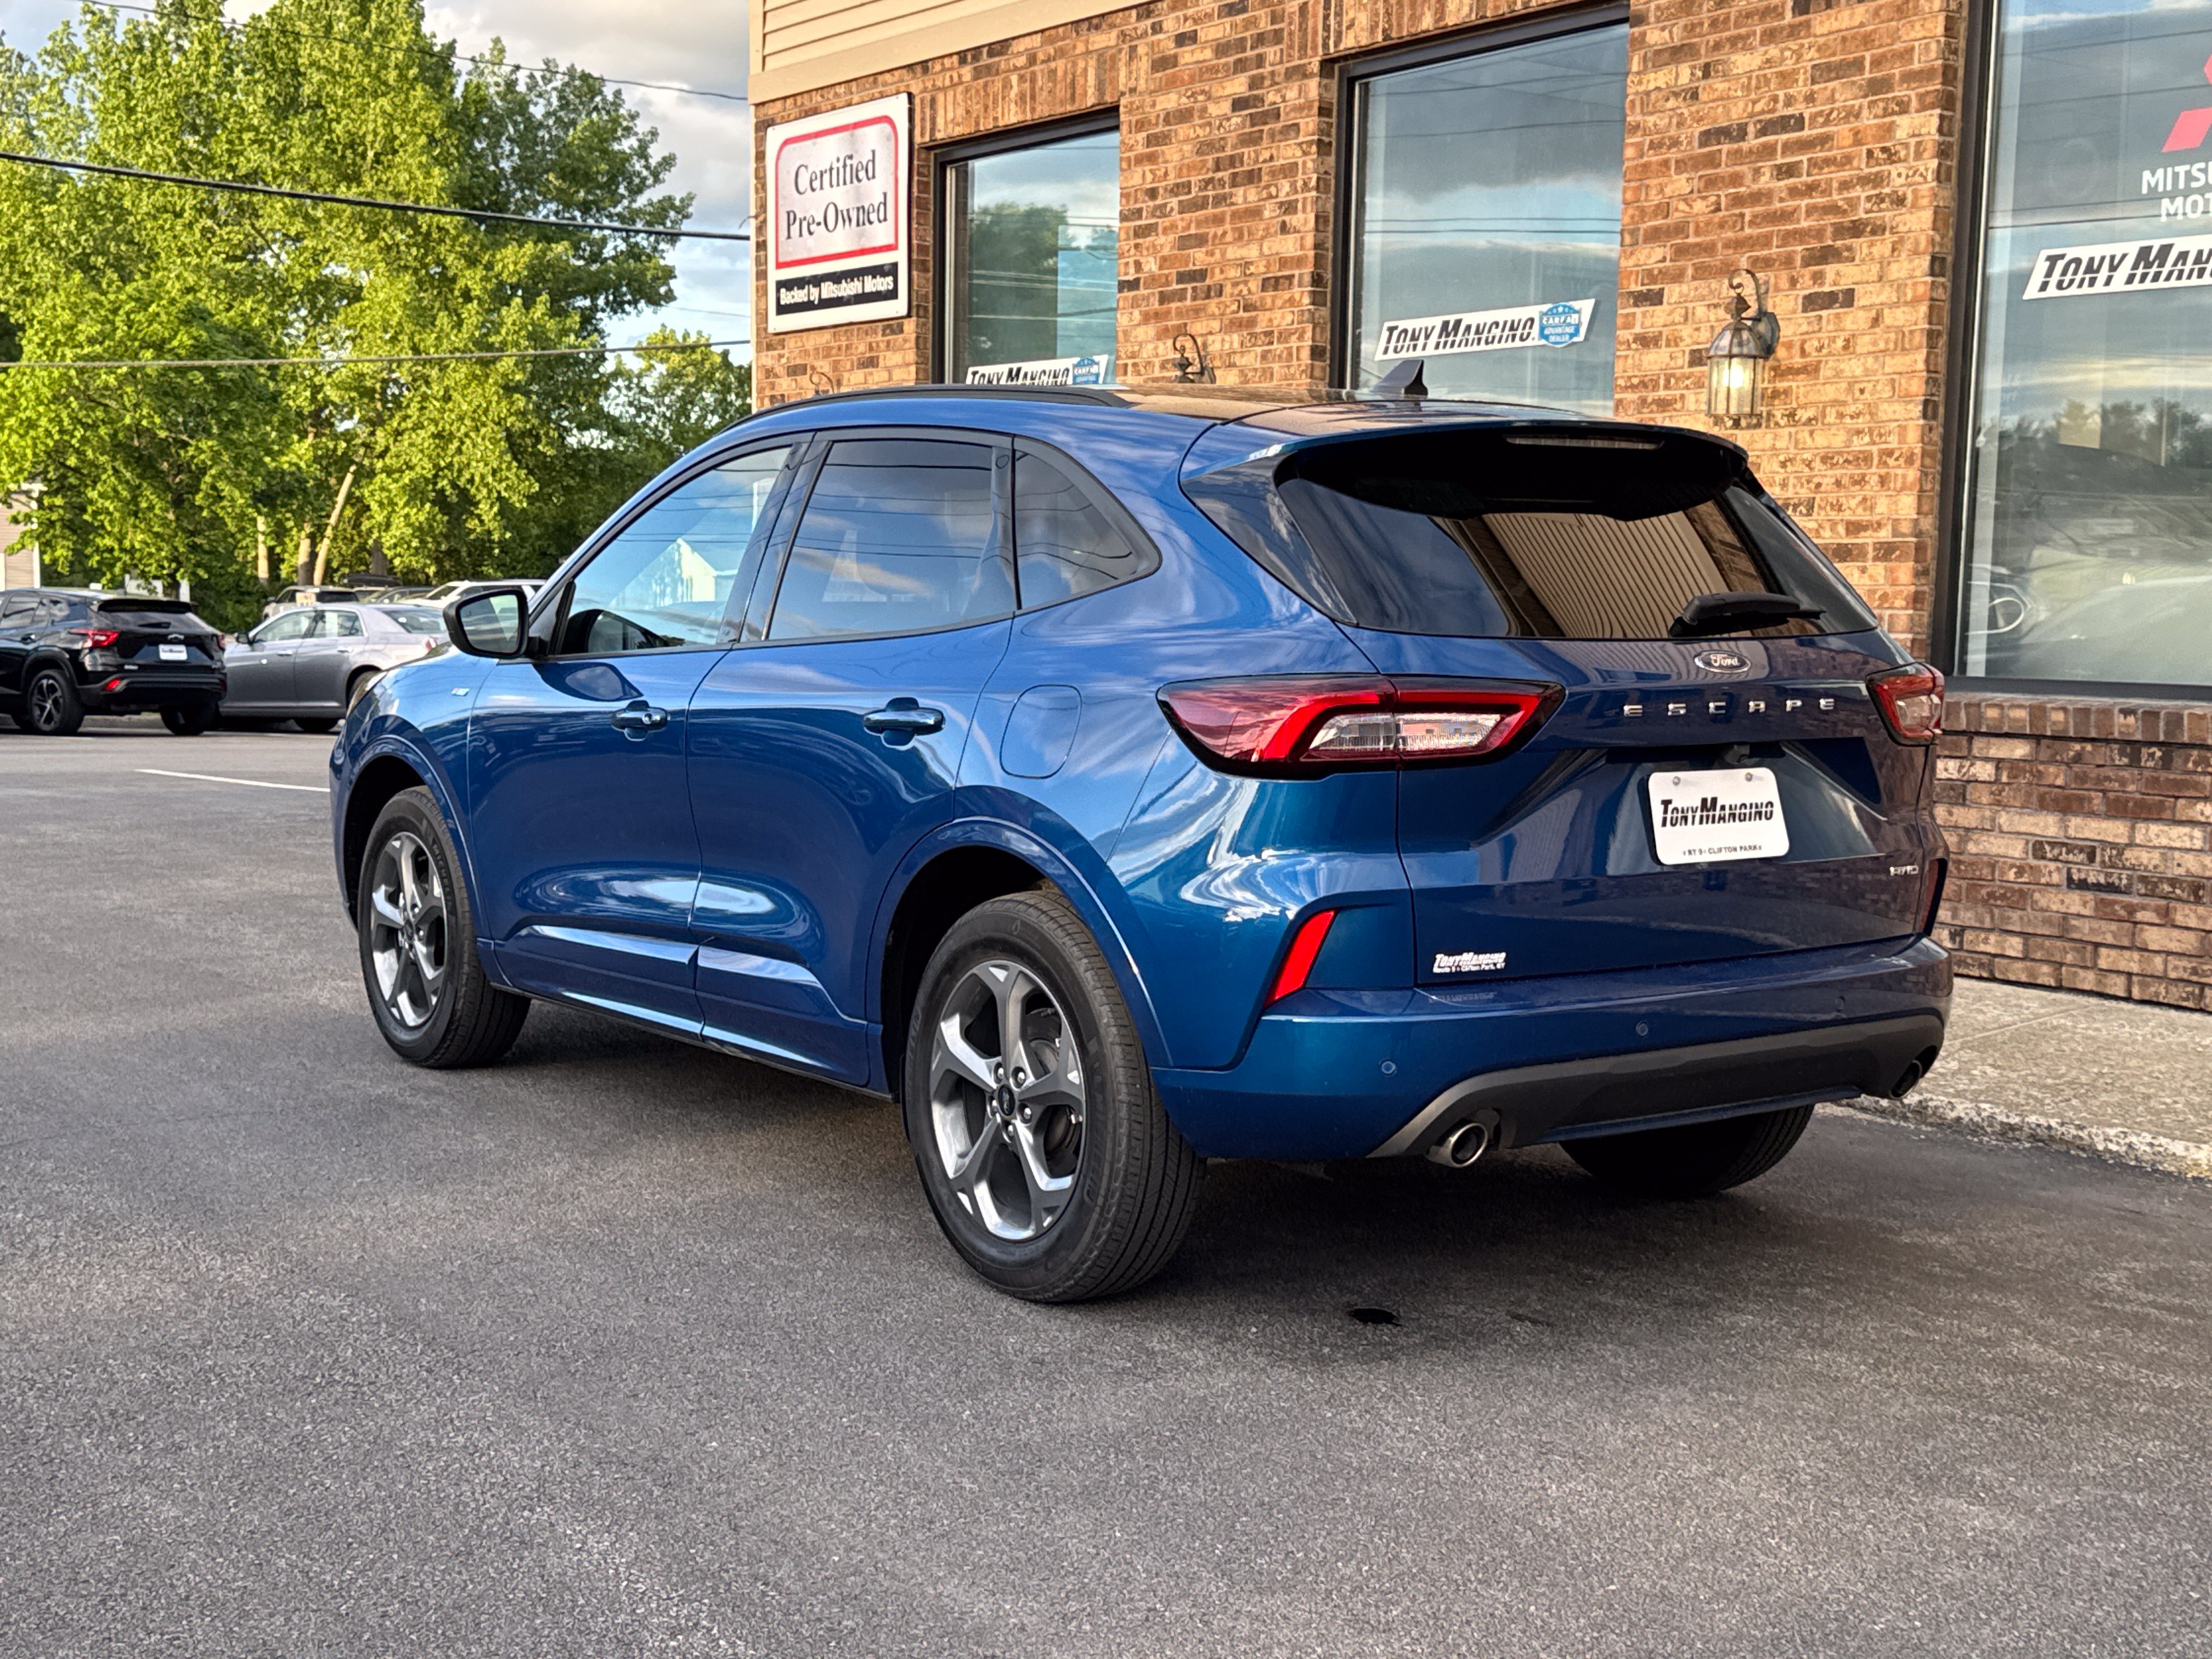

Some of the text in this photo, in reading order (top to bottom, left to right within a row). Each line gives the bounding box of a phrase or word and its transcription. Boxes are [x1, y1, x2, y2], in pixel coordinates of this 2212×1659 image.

[794, 149, 877, 195] Certified
[2141, 161, 2212, 195] MITS
[785, 191, 888, 241] Pre-Owned
[2038, 243, 2212, 293] TONY MAN
[780, 275, 894, 305] Backed by Mitsubishi Motors
[1382, 318, 1536, 356] TONY MANGINO
[1709, 653, 1741, 667] Ford
[1623, 698, 1835, 716] ESCAPE
